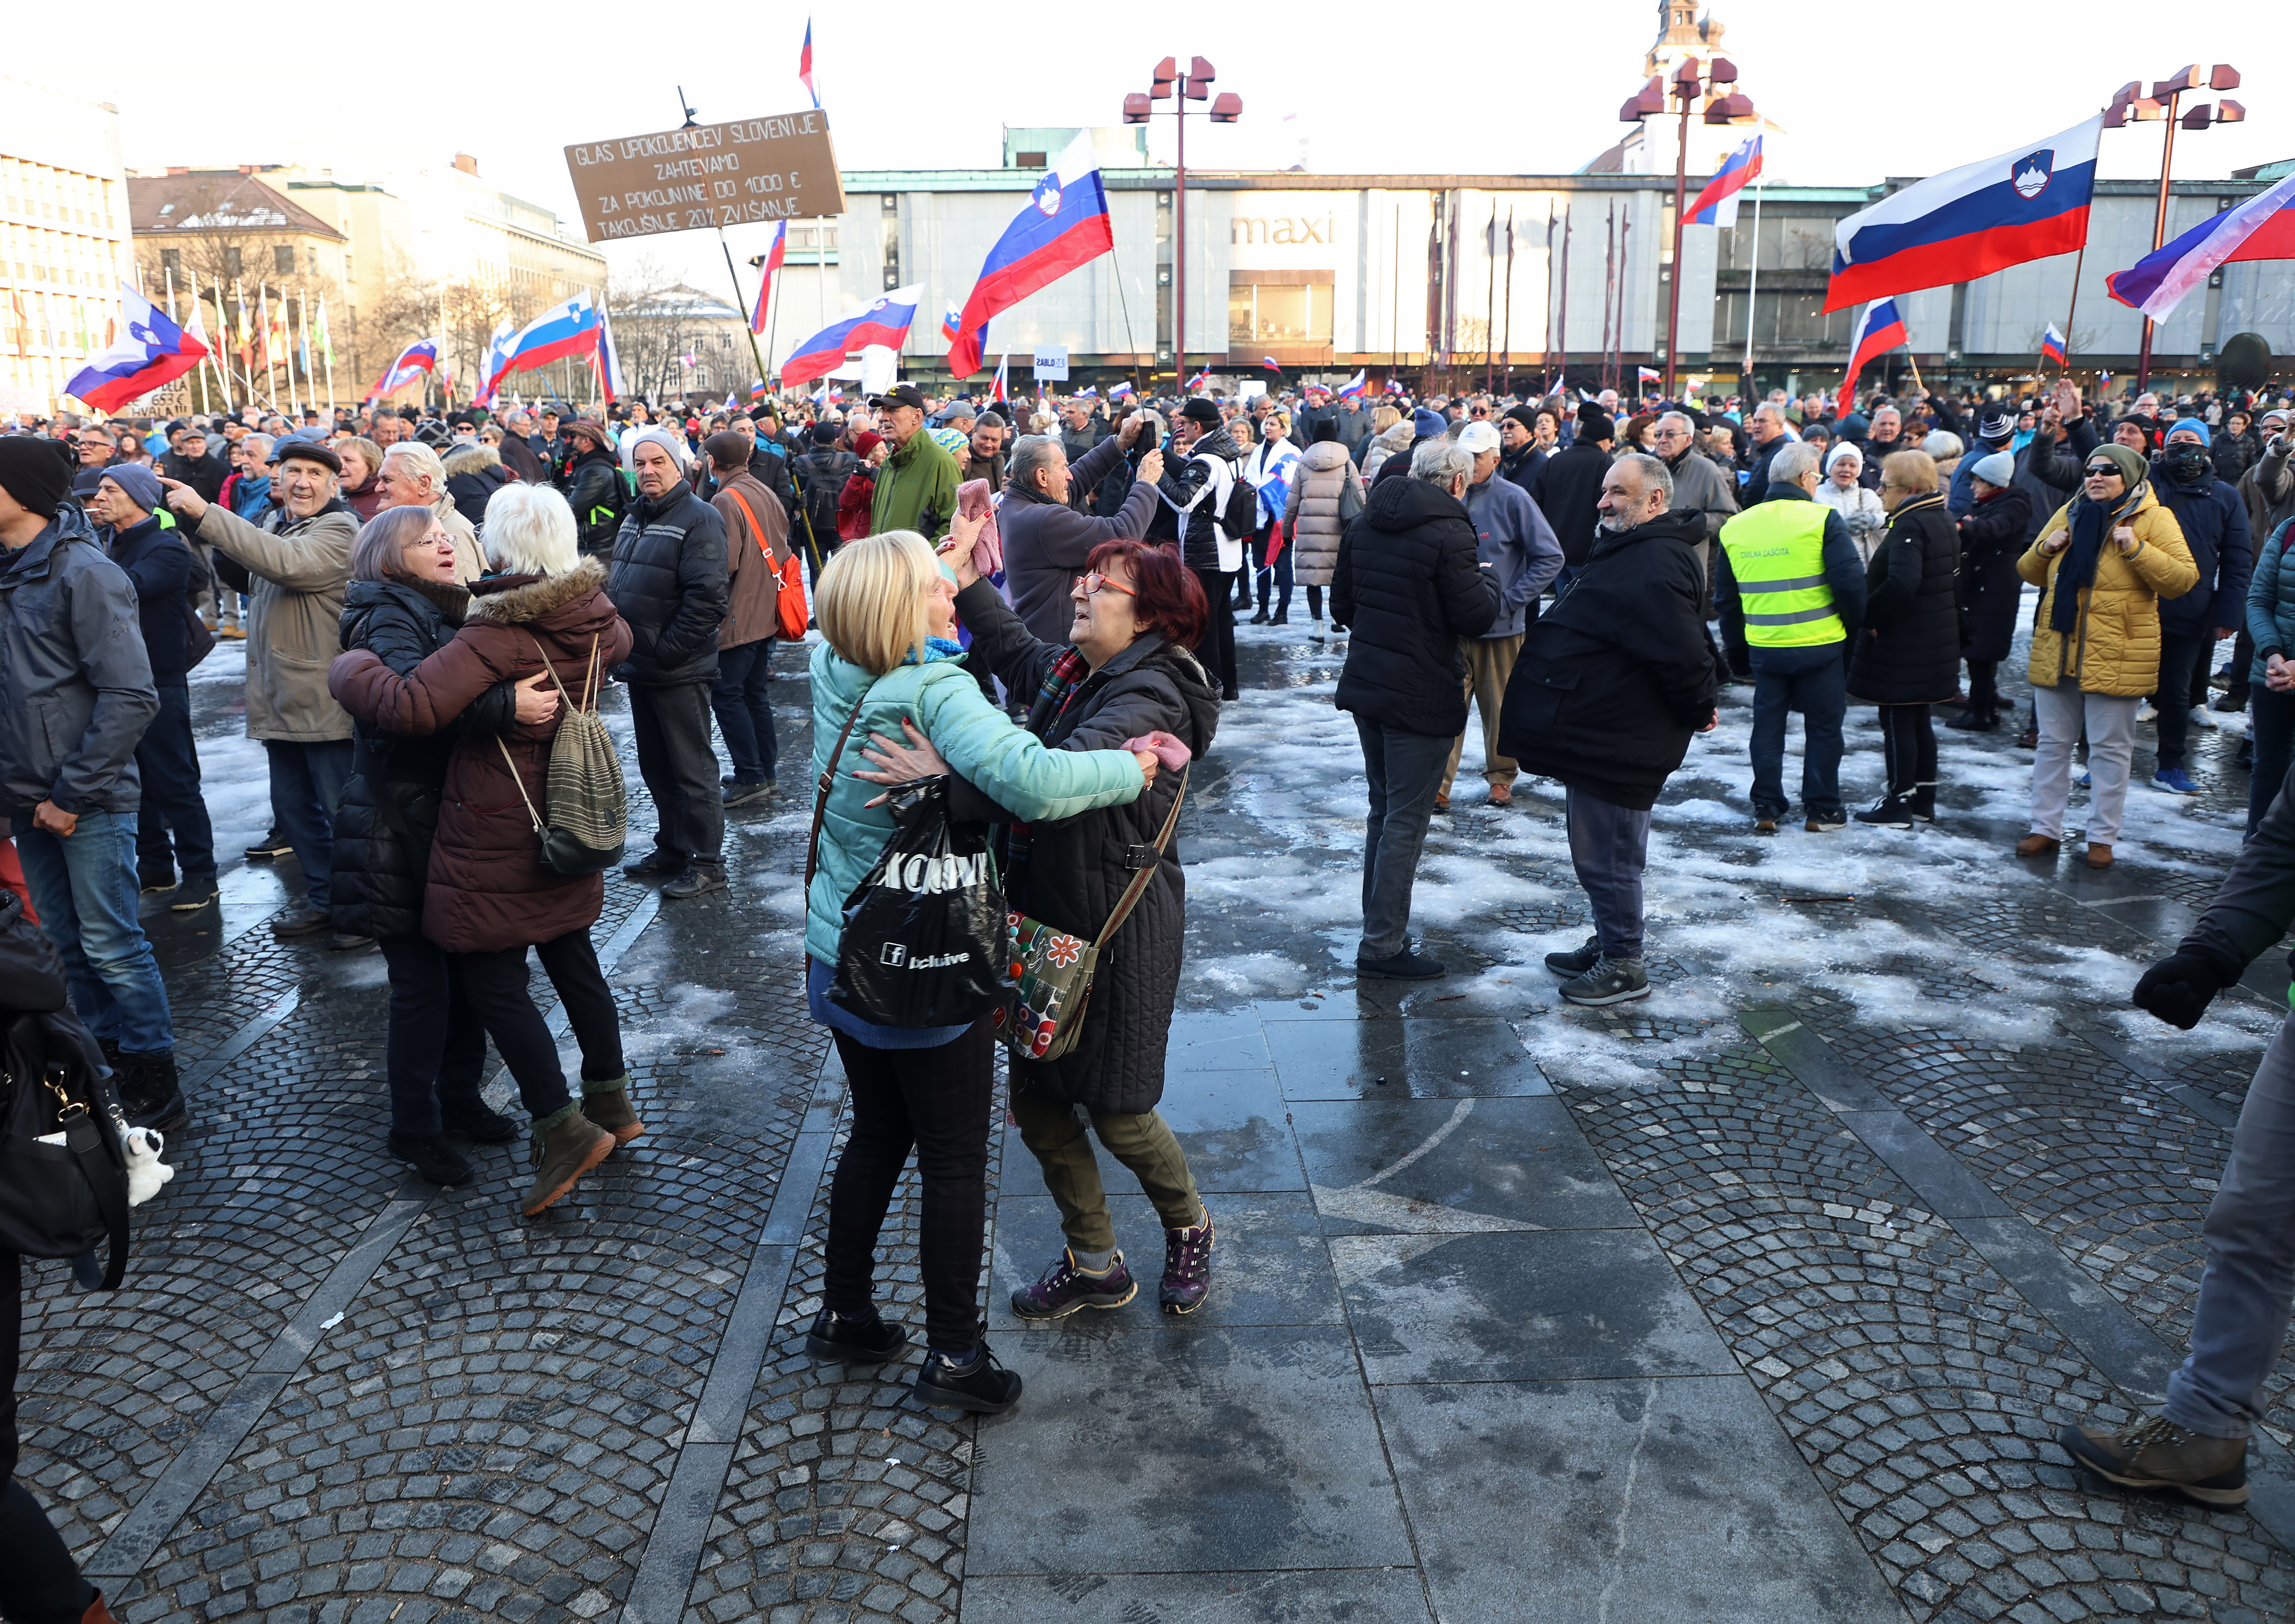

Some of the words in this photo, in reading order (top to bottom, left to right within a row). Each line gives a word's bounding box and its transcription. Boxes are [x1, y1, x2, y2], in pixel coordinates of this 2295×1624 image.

[575, 143, 614, 166] GLAS
[620, 127, 722, 159] UPOKOJENCEV
[730, 114, 819, 143] SLOVENIJE
[654, 152, 740, 180] ZAHTEVAMO
[599, 196, 620, 214] ZA
[625, 183, 708, 210] POKOJNINE
[714, 180, 736, 199] DO
[745, 173, 783, 194] 1000
[790, 172, 802, 189] €
[597, 211, 681, 238] TAKOJŠNJE
[686, 208, 717, 228] 20%
[720, 196, 802, 224] ZVIŠANJE
[1231, 211, 1334, 244] maxi
[152, 393, 173, 405] 653
